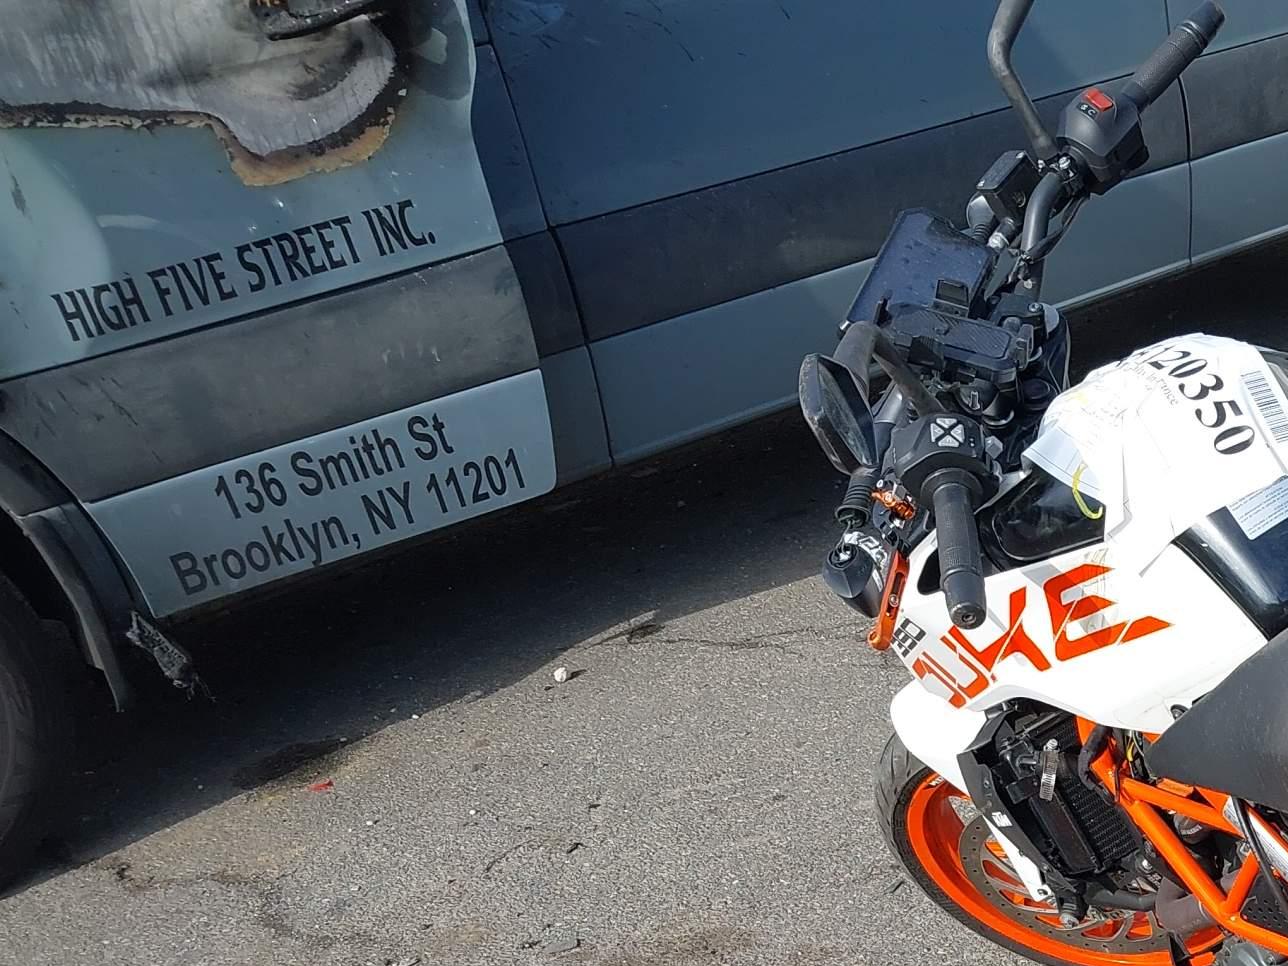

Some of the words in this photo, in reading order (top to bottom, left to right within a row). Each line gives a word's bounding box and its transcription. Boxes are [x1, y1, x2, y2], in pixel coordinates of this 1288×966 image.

[50, 277, 152, 342] HIGH
[146, 252, 239, 317] FIVE
[233, 215, 361, 293] STREET
[361, 199, 436, 257] INC.
[169, 517, 362, 596] Brooklyn,
[360, 480, 415, 536] NY
[426, 448, 526, 514] 11201
[215, 461, 288, 519] 136
[290, 429, 406, 497] Smith
[407, 413, 455, 461] St
[911, 563, 1175, 709] DUKE
